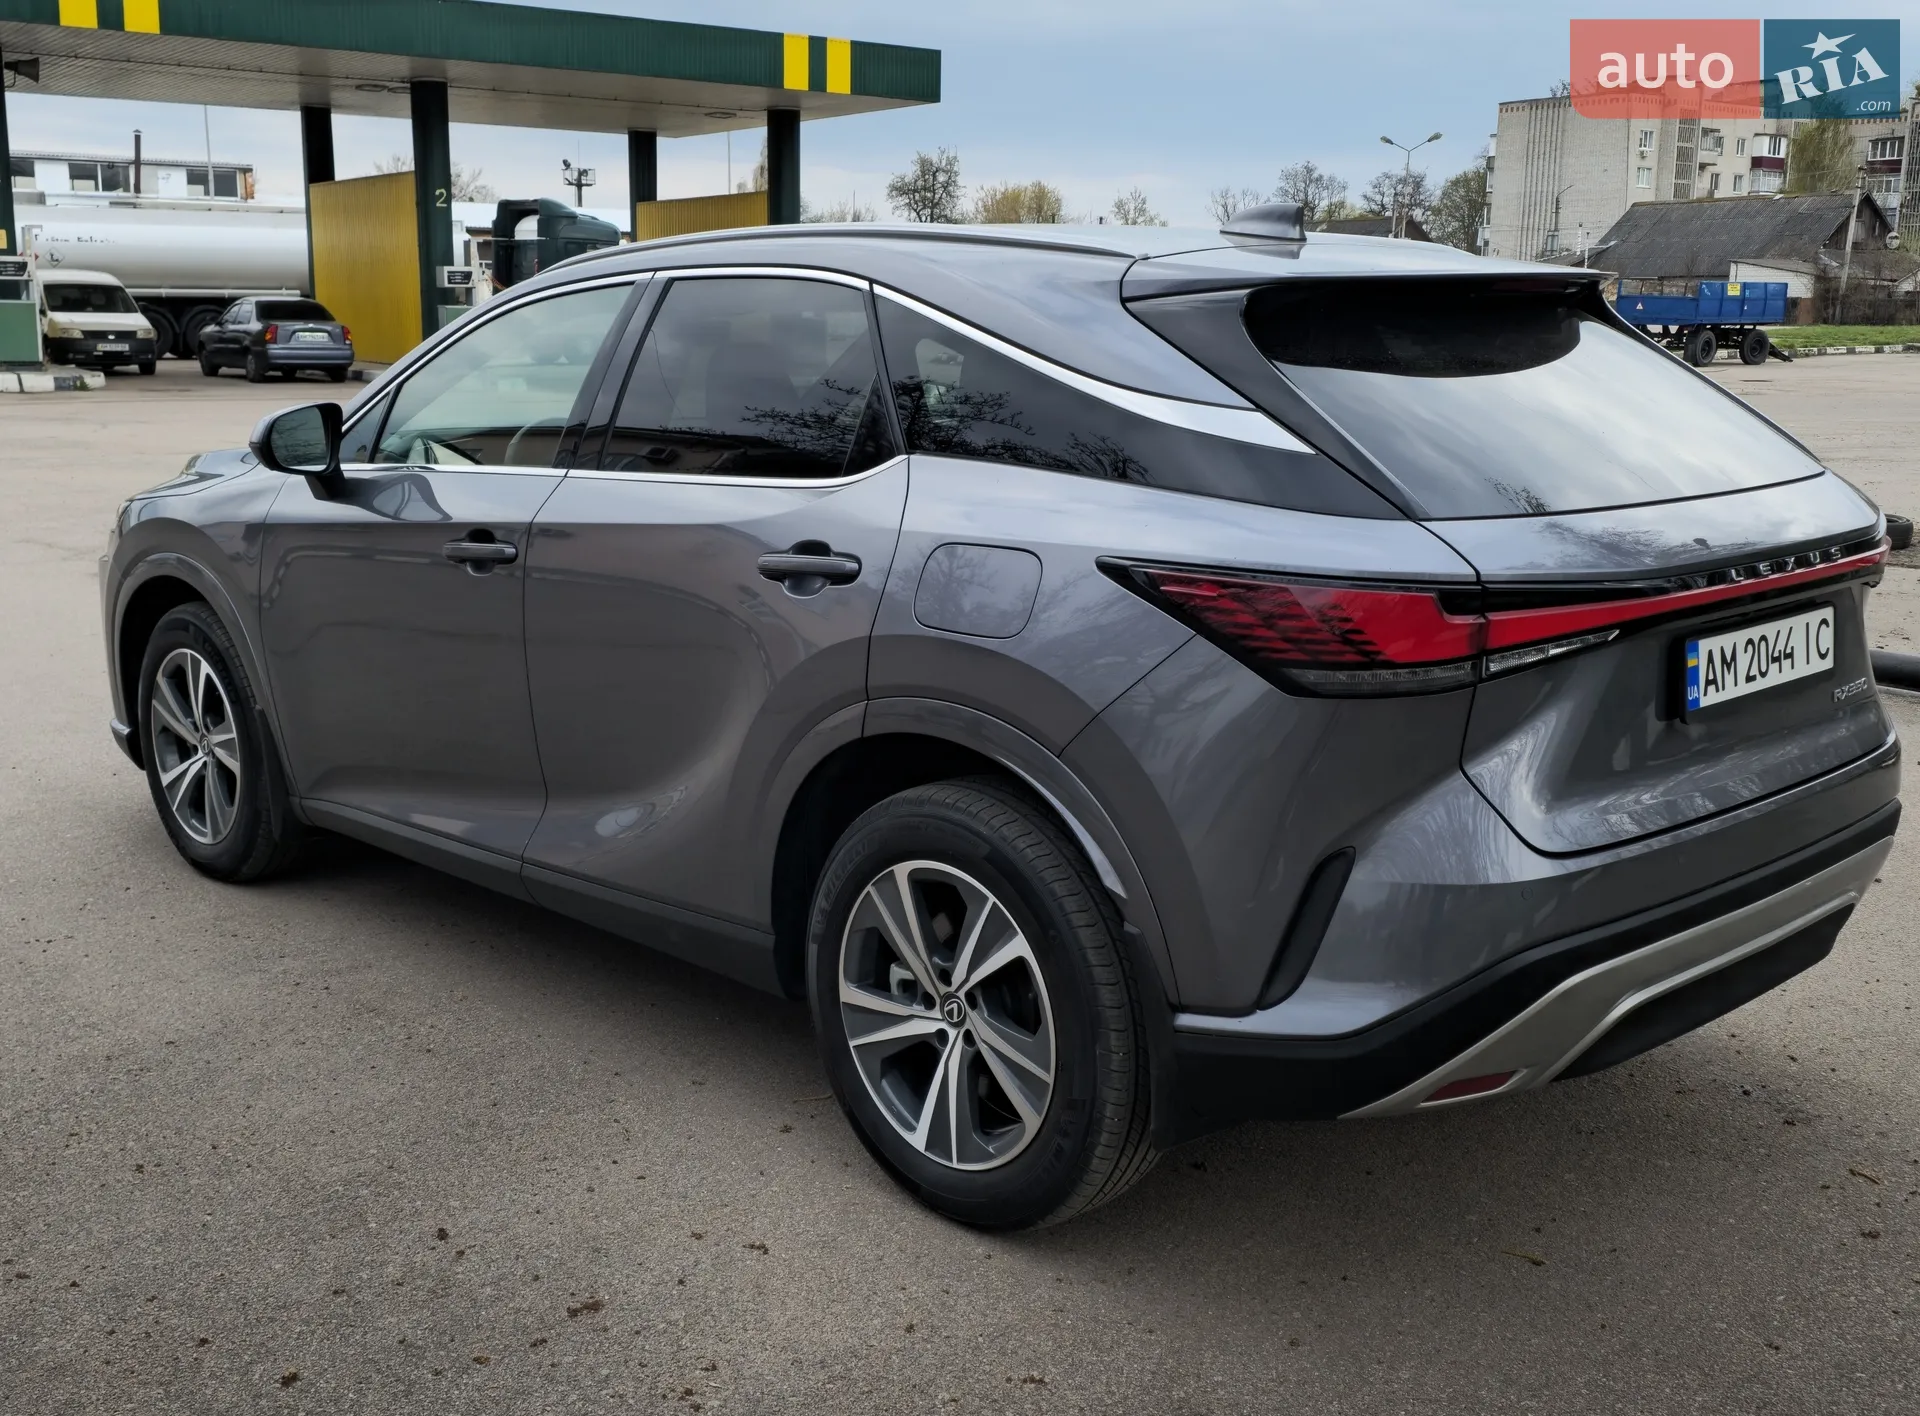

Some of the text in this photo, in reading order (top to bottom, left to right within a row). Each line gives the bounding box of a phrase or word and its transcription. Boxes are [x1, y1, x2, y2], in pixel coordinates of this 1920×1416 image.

[434, 188, 448, 207] 2
[1730, 546, 1842, 581] LEXUS
[1703, 617, 1830, 697] AM 2044 IC
[1687, 684, 1699, 700] UA
